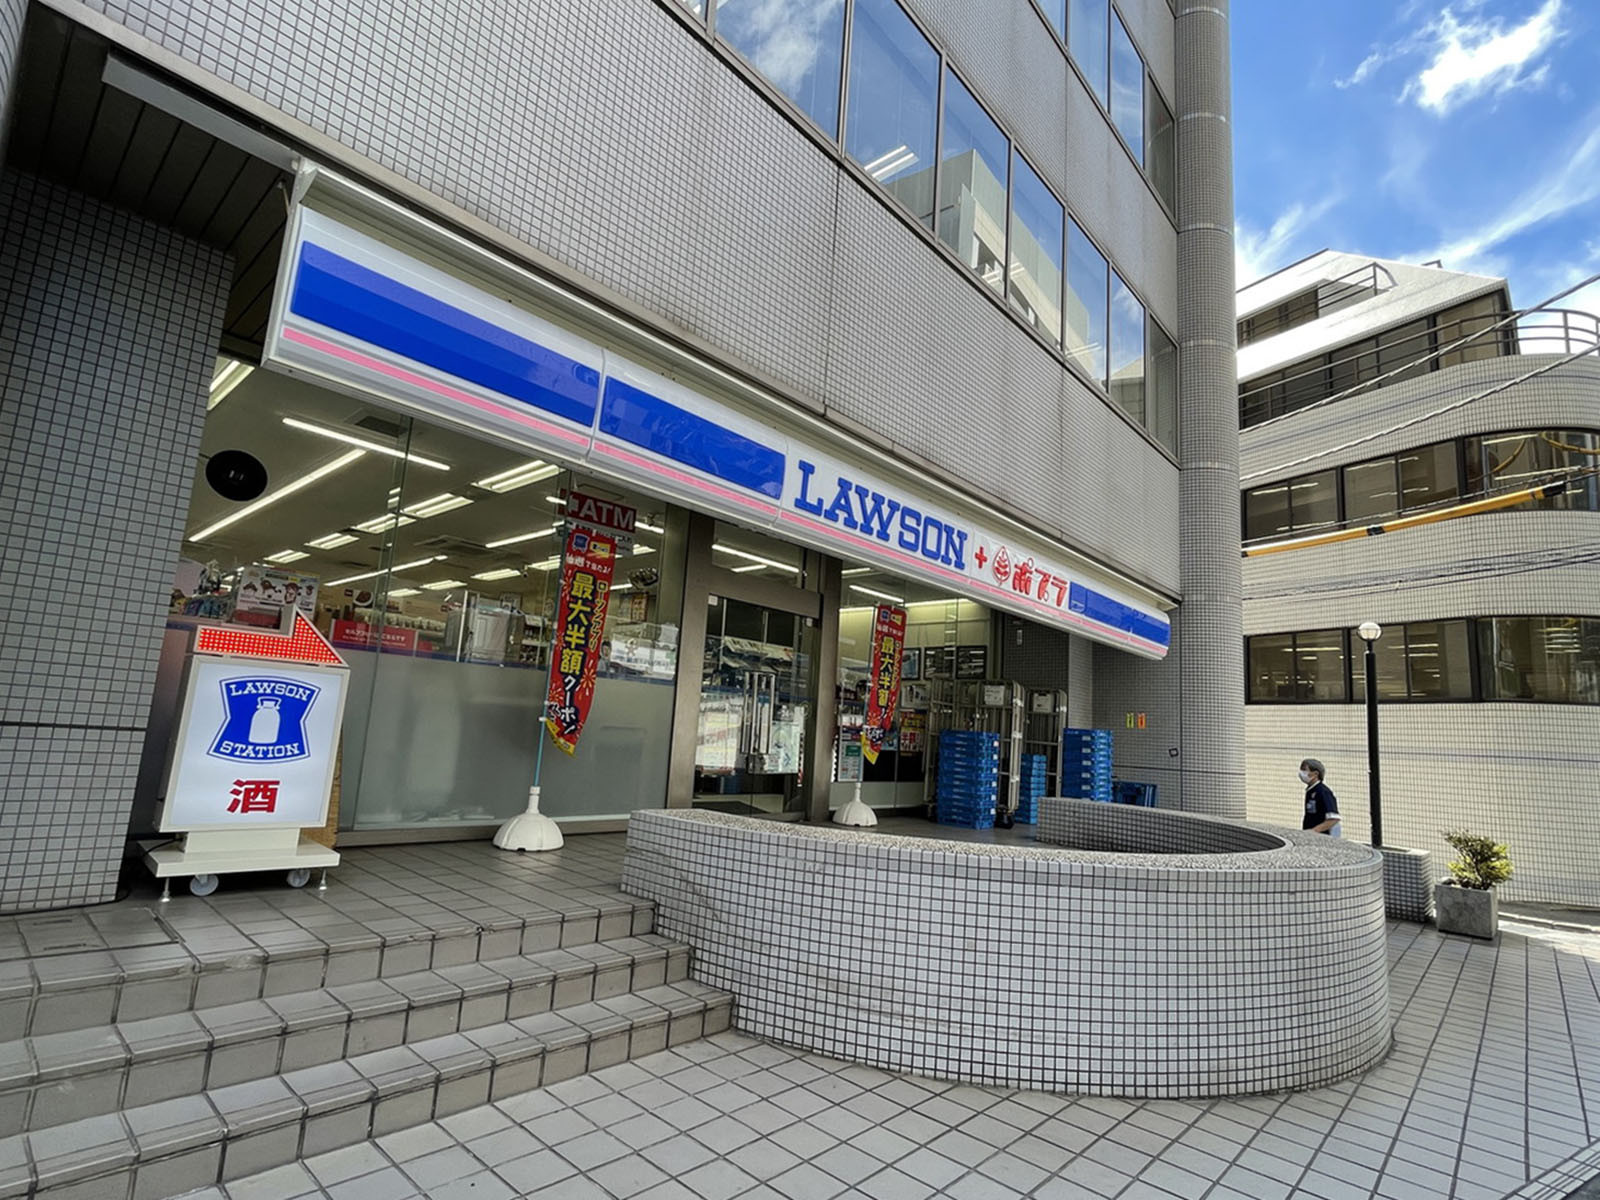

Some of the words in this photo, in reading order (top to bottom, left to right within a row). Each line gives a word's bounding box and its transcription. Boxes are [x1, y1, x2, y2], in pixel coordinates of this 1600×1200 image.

[579, 498, 635, 531] ATM
[794, 459, 968, 570] LAWSON
[1012, 556, 1069, 609] ポプラ
[560, 572, 594, 735] 最大半額クーポン
[229, 682, 311, 702] LAWSON
[220, 740, 301, 758] STATION
[227, 779, 281, 814] 酒
